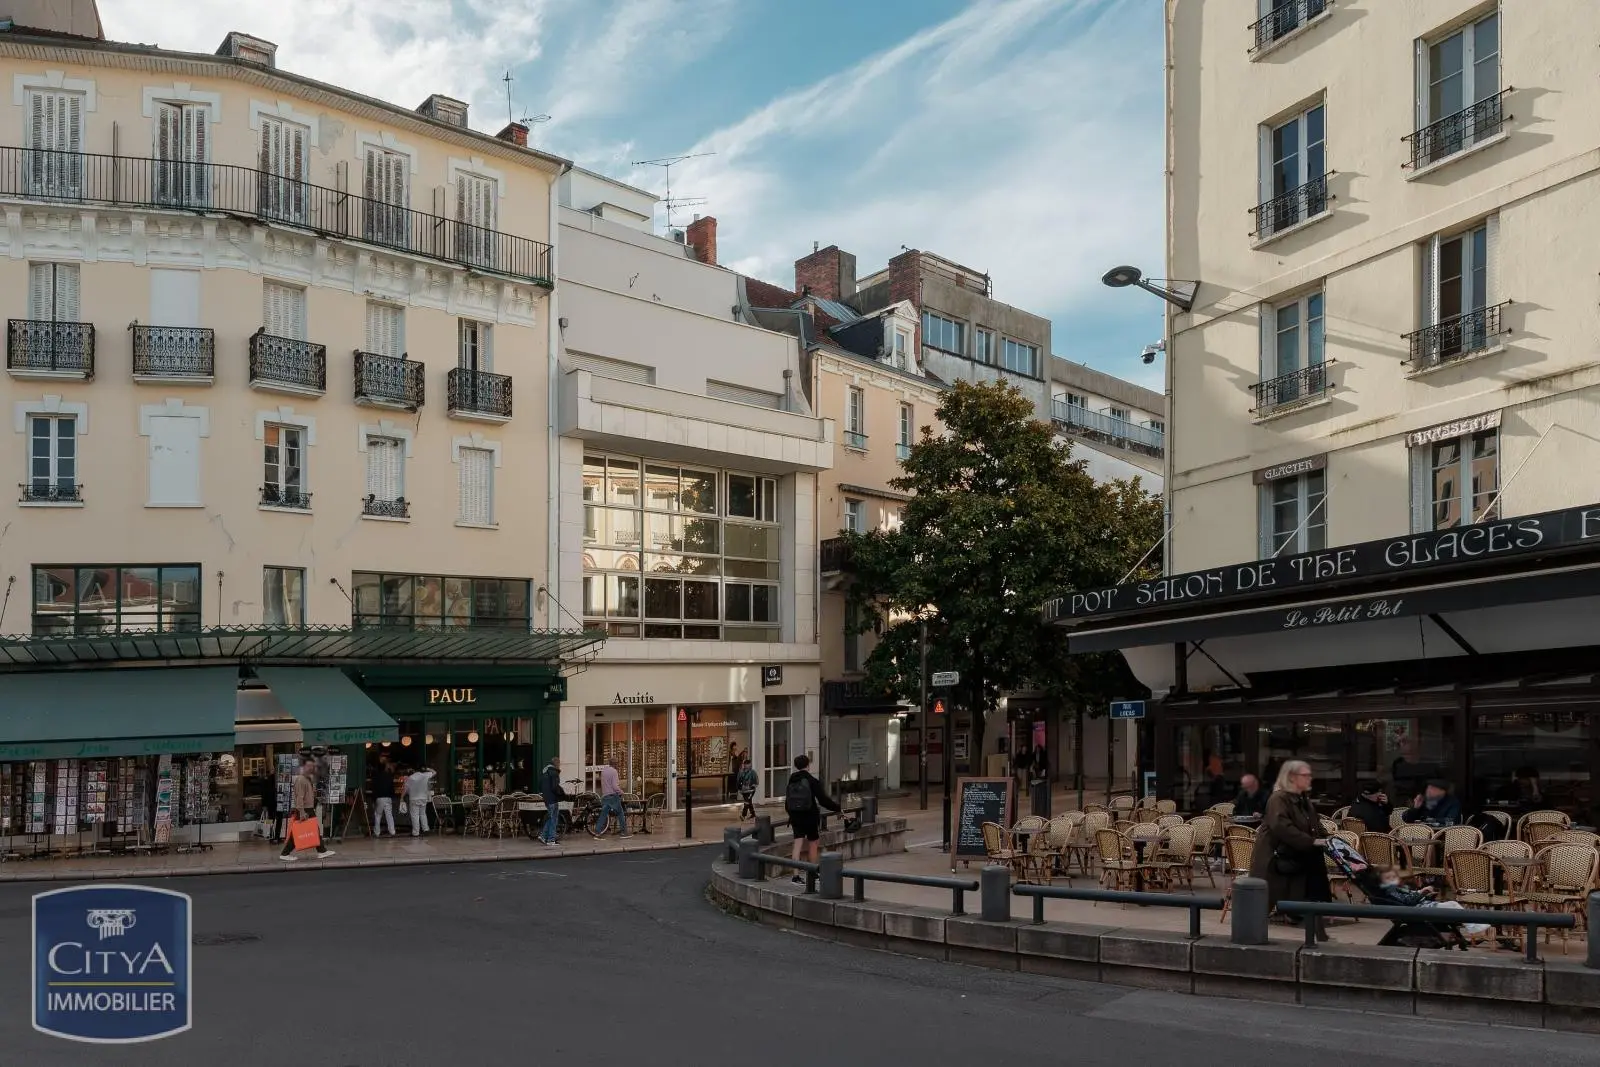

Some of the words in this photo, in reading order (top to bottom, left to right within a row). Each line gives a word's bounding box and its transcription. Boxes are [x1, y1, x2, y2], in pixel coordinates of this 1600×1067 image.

[1264, 459, 1313, 479] GLACIER
[1071, 588, 1118, 614] POT
[1136, 571, 1223, 605] SALON
[1236, 562, 1277, 590] DE
[1384, 518, 1543, 567] GLACES
[1283, 609, 1309, 628] Le
[1313, 604, 1362, 624] Petit
[1366, 599, 1404, 618] Pot
[429, 688, 478, 704] PAUL
[612, 691, 655, 705] Acuitis
